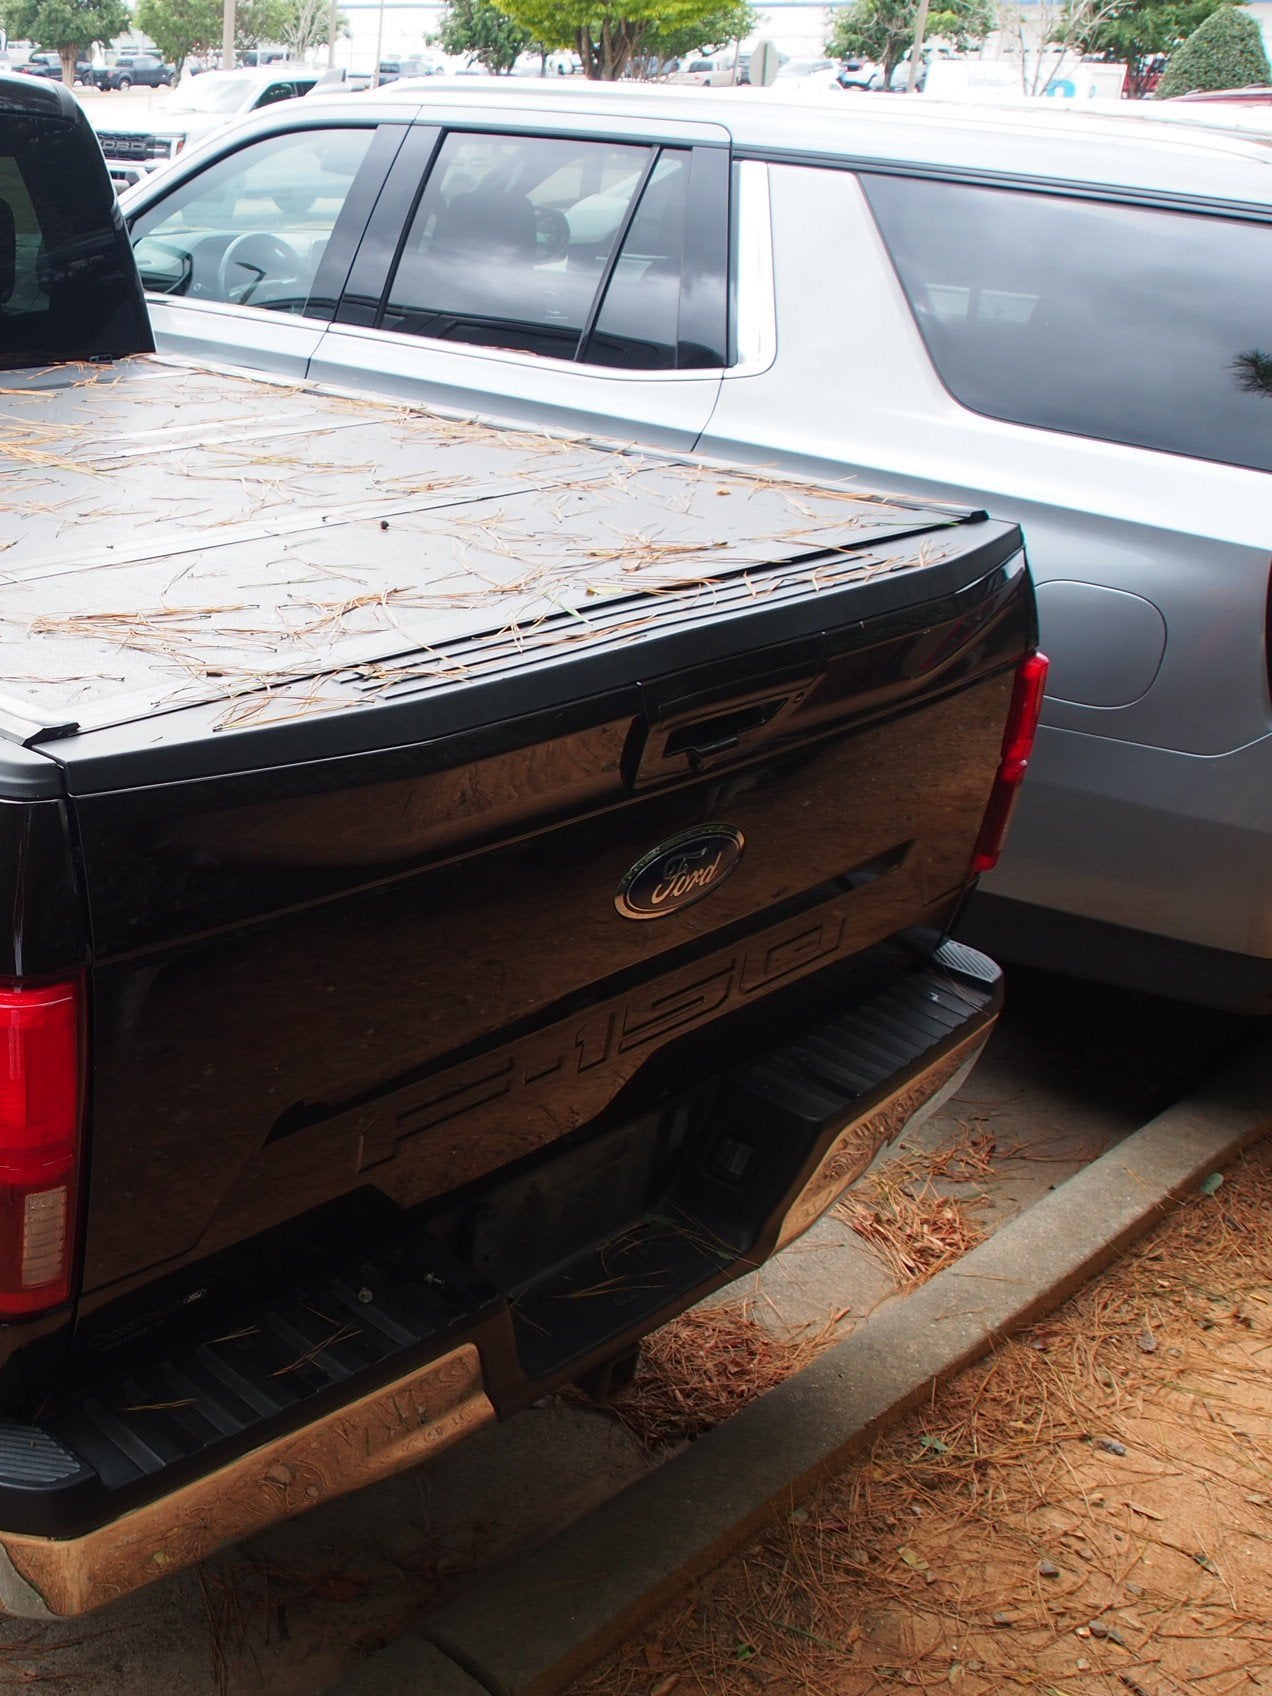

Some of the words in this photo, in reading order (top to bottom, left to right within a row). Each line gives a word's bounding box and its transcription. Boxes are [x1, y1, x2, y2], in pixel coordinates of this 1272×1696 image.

[99, 139, 146, 151] ORD
[650, 846, 724, 905] Ford
[356, 911, 847, 1174] F-150
